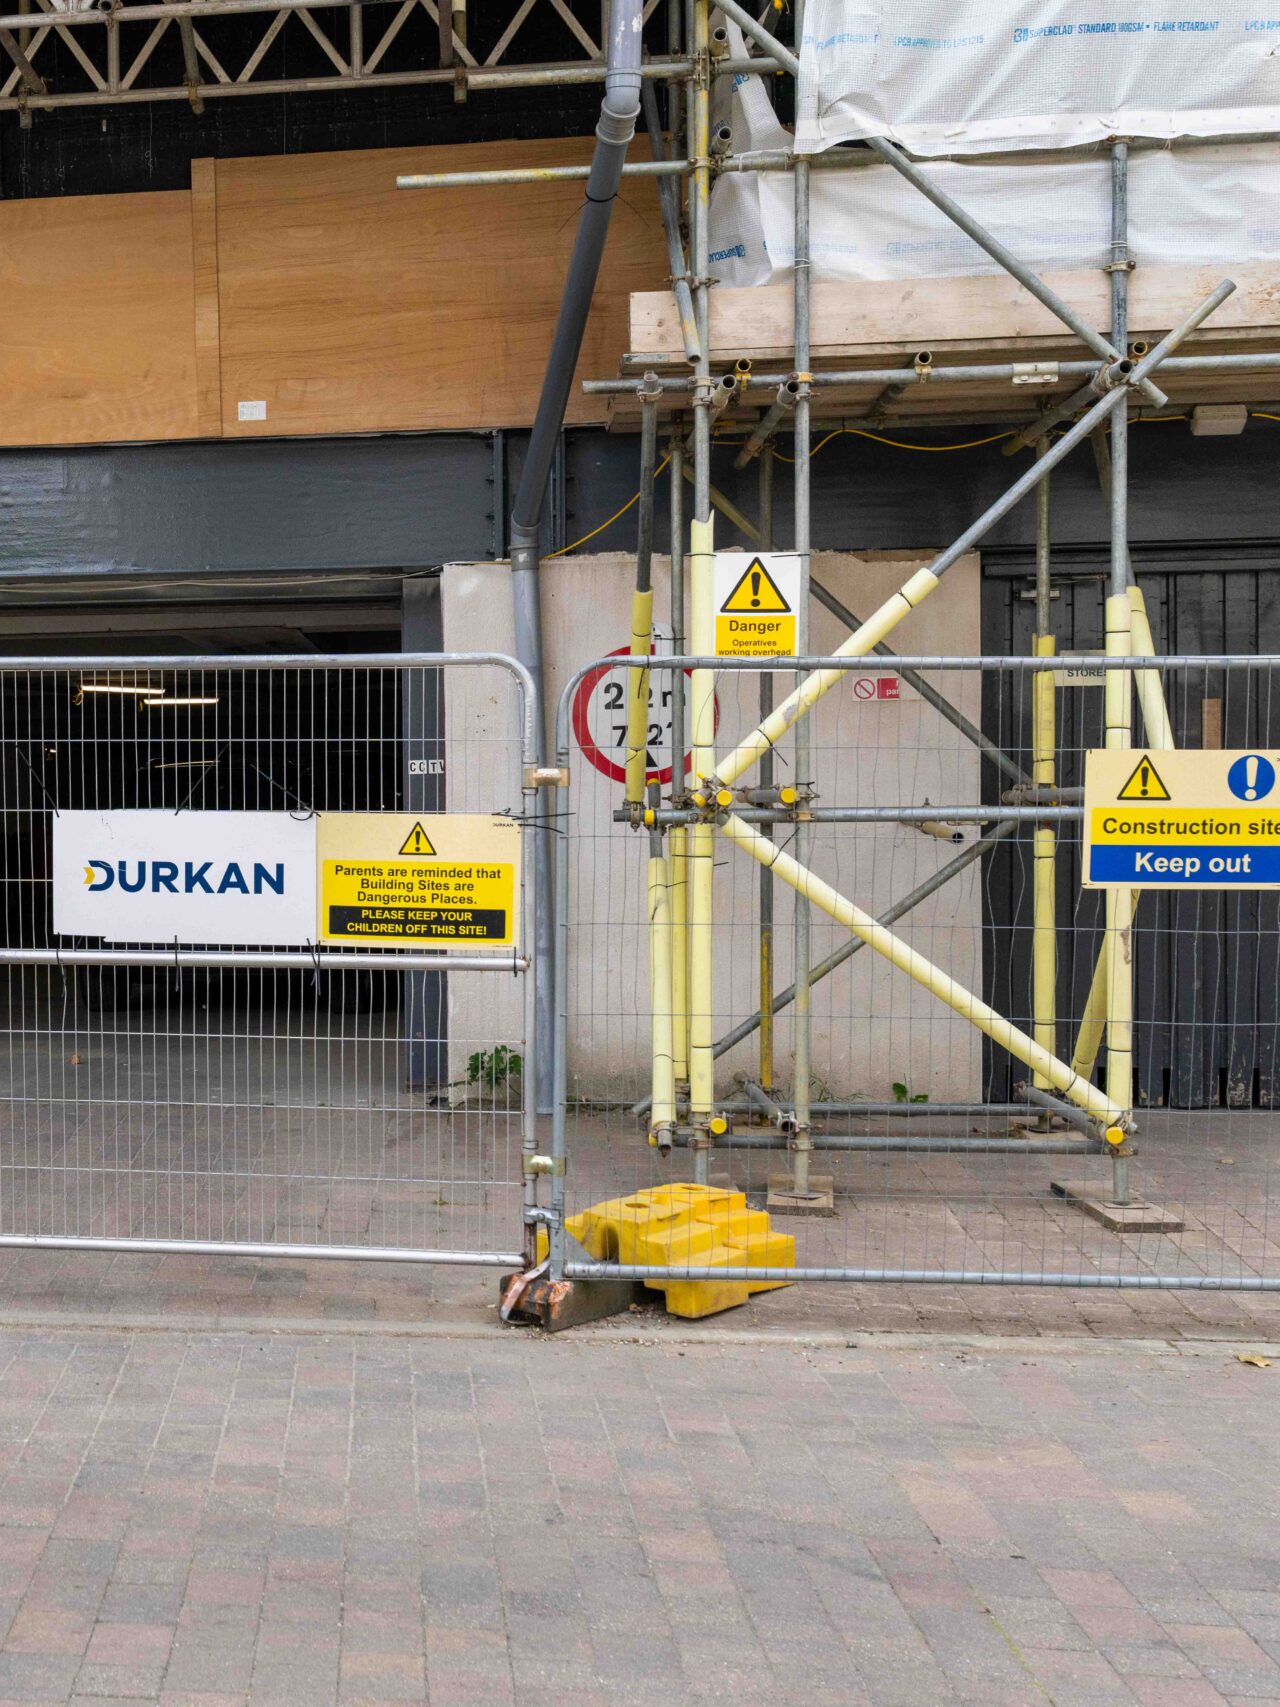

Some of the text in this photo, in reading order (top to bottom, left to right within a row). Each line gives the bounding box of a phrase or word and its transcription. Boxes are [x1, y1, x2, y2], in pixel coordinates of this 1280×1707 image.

[1078, 22, 1116, 35] STANDARD
[1177, 21, 1219, 32] RETARDANT
[729, 620, 781, 635] Danger
[732, 639, 777, 648] Operatives
[718, 648, 791, 656] working overhead
[1102, 817, 1241, 835] Construction
[335, 865, 501, 879] Parents are reminded that
[1135, 852, 1252, 878] Keep out
[83, 860, 284, 894] DURKAN
[360, 879, 474, 892] Building Sites are
[357, 891, 477, 905] Dangerous Places.
[361, 910, 473, 921] PLEASE KEEP YOUR
[346, 922, 487, 935] CHILDREN OFF THIS SITE!
